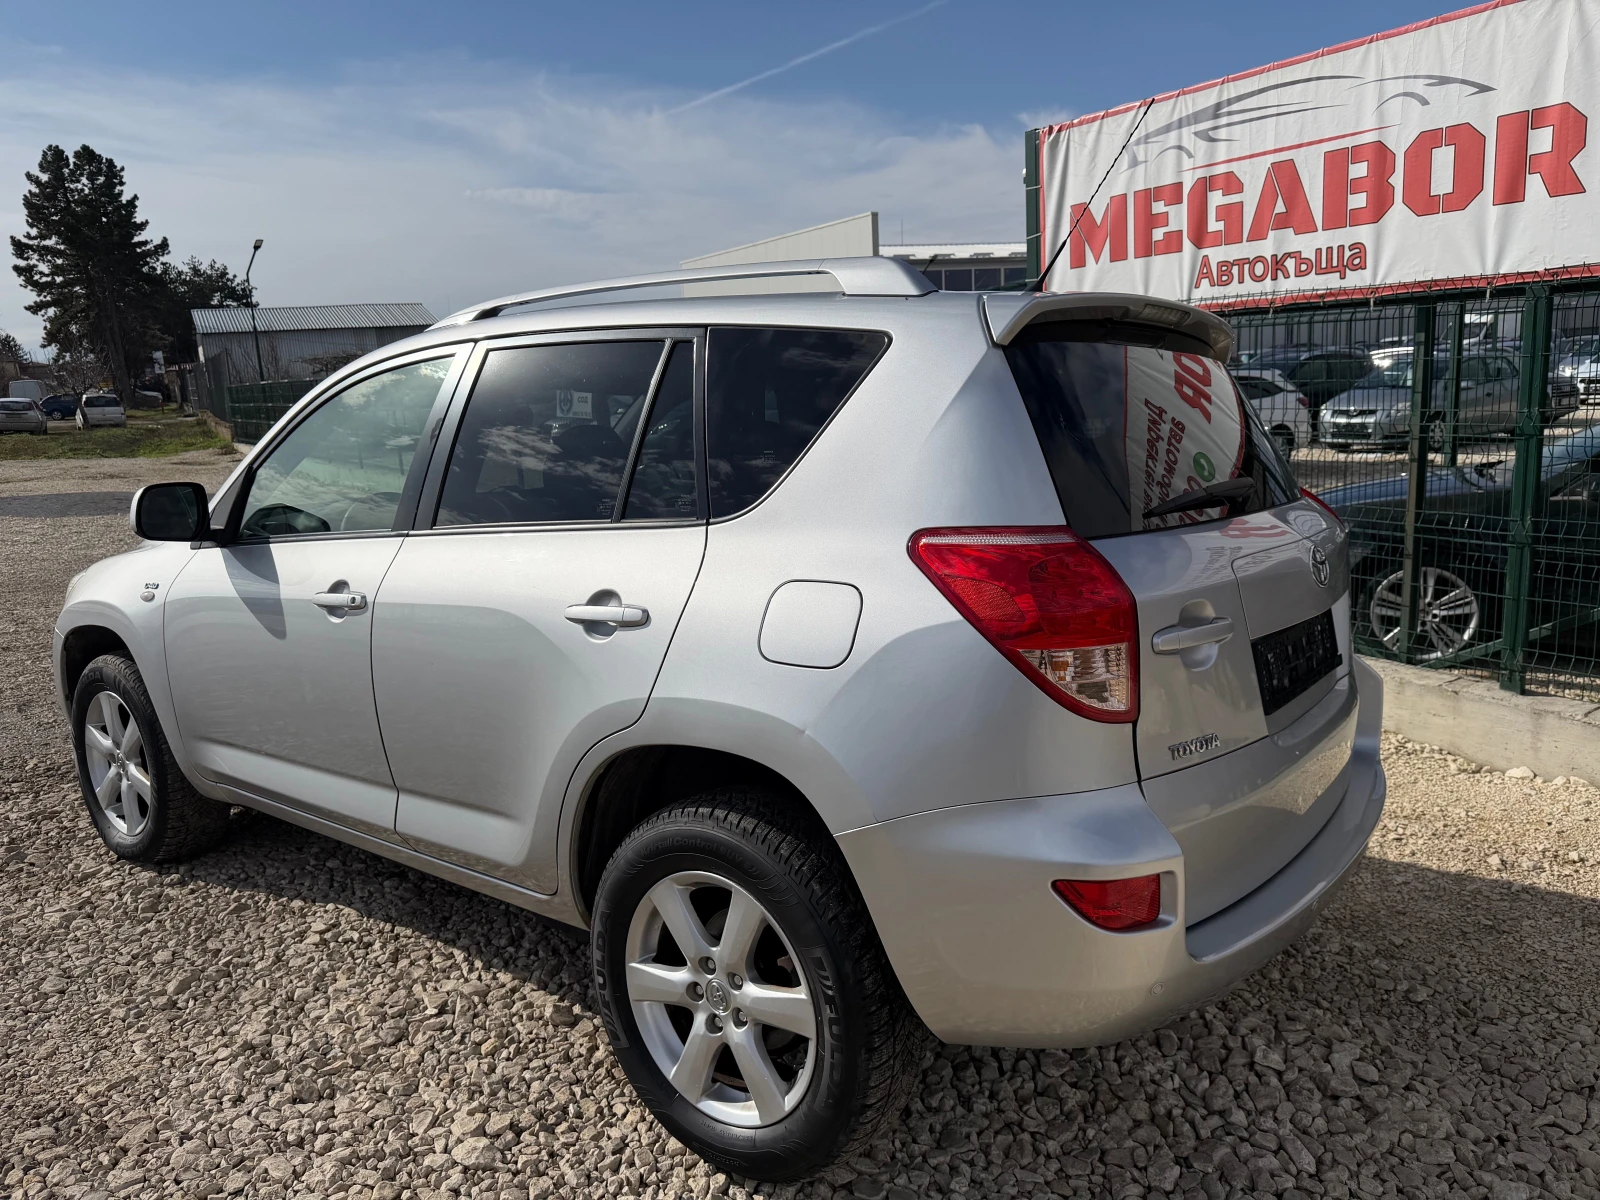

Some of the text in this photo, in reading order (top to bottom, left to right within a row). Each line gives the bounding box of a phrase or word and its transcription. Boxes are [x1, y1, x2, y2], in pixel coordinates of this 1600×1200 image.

[1068, 101, 1588, 271] MEGABOR
[1194, 241, 1368, 289] Автокъща
[1168, 732, 1221, 760] TOYOTA
